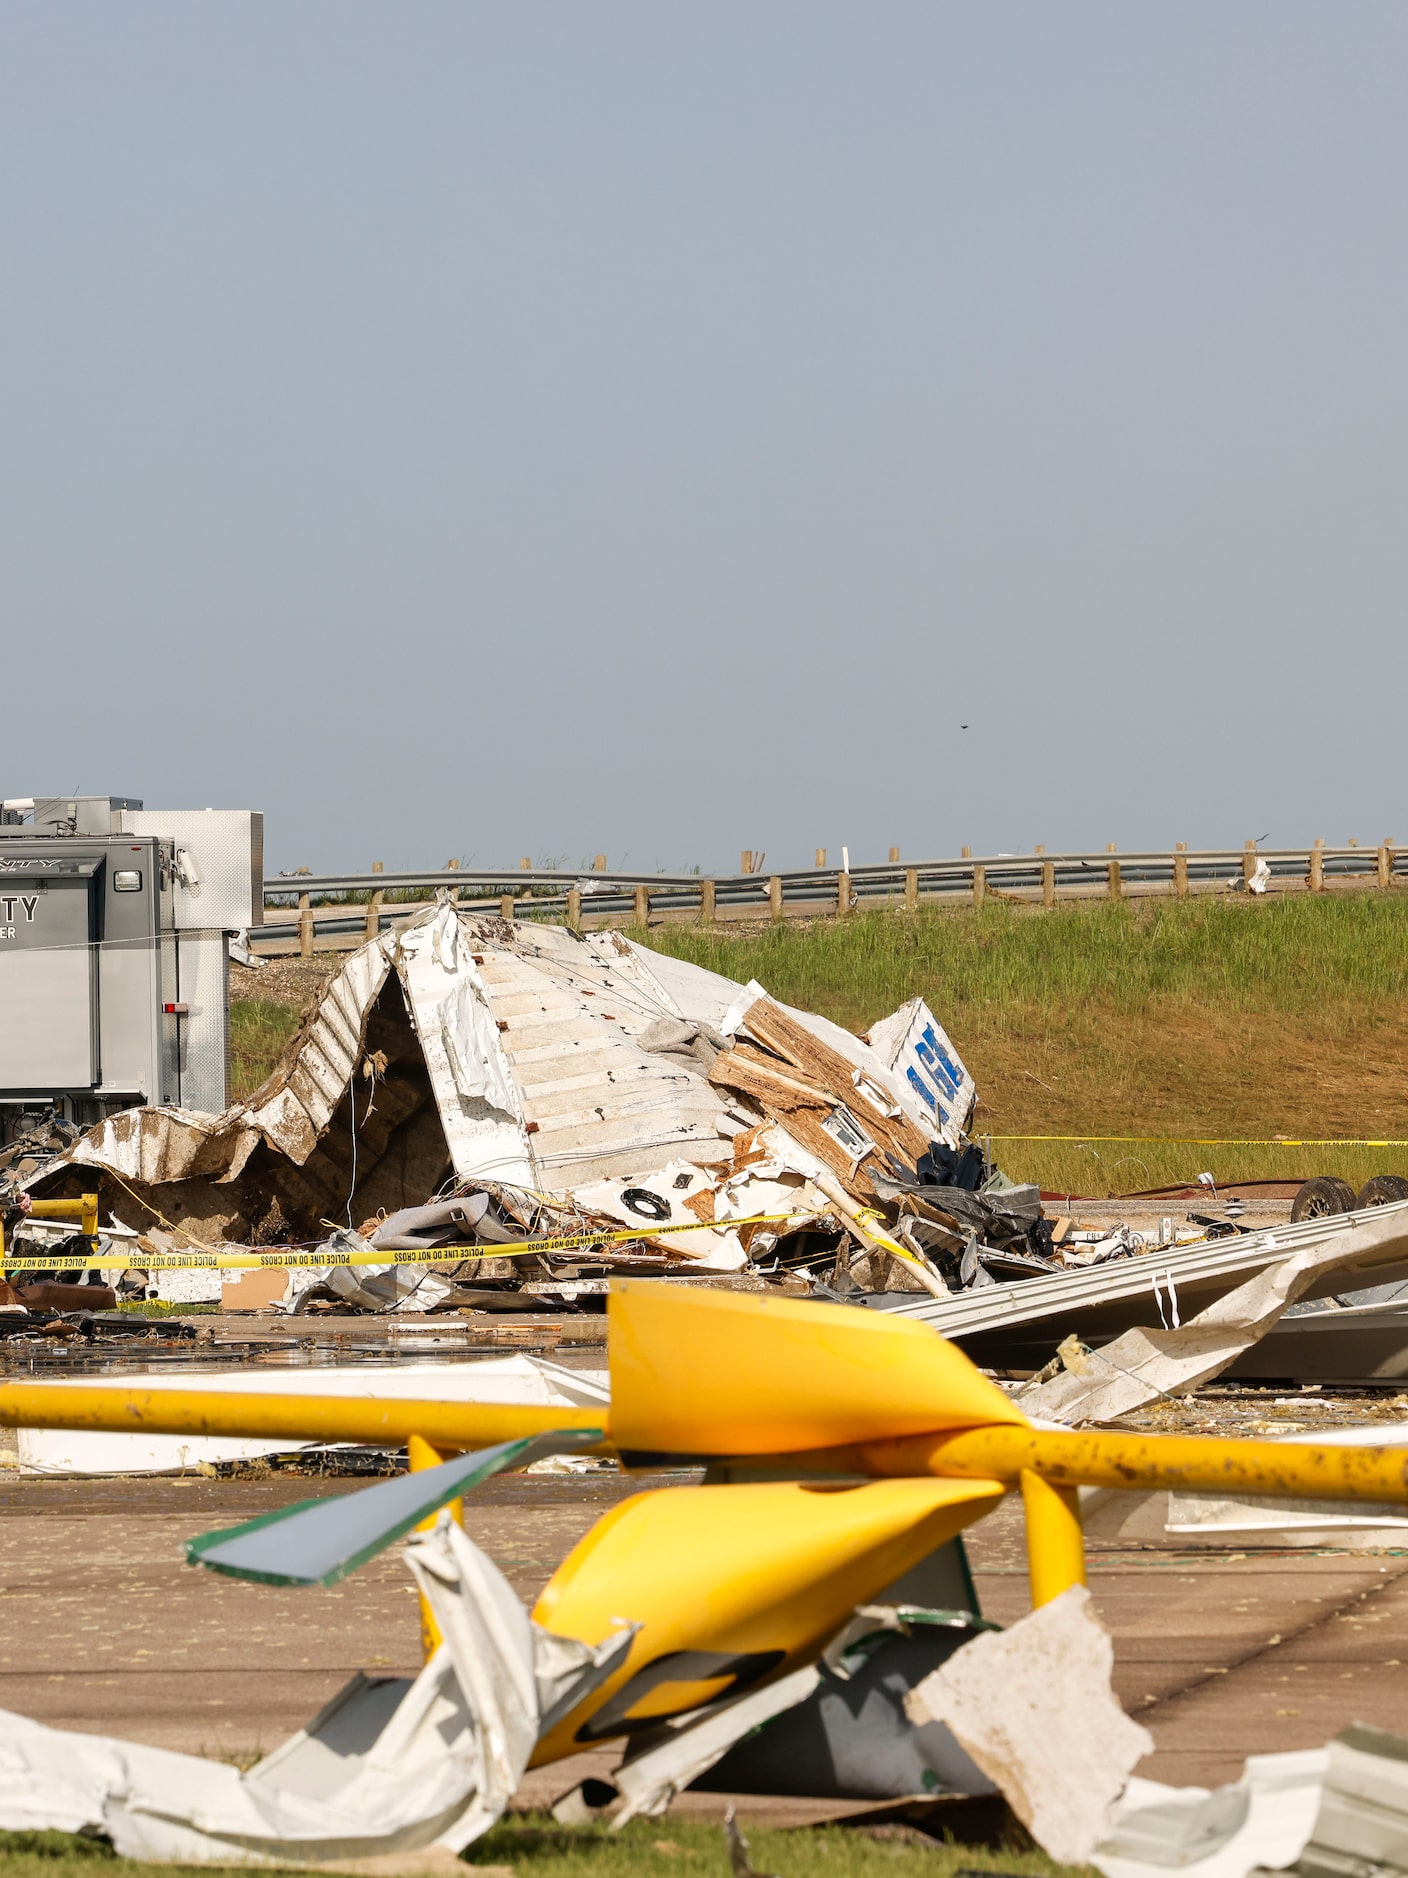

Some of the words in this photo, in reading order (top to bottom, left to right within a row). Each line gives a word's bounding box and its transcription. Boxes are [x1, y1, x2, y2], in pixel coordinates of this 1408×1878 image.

[565, 1239, 575, 1247] DO
[576, 1237, 591, 1246] LINE
[592, 1234, 616, 1244] POLICE
[527, 1242, 549, 1252] CROSS
[550, 1240, 564, 1249] NOT
[394, 1252, 416, 1262] CROSS
[418, 1251, 431, 1261] NOT
[433, 1250, 442, 1260] DO
[444, 1249, 459, 1259] LINE
[460, 1248, 484, 1258] POLICE
[0, 1259, 22, 1268] CROSS
[23, 1259, 36, 1268] NOT
[37, 1259, 47, 1268] DO
[47, 1258, 63, 1267] LINE
[63, 1258, 87, 1267] POLICE
[129, 1257, 151, 1267] CROSS
[152, 1257, 166, 1266] NOT
[166, 1257, 176, 1266] DO
[177, 1256, 192, 1266] LINE
[194, 1256, 217, 1266] POLICE
[260, 1255, 283, 1266] CROSS
[284, 1255, 297, 1265] NOT
[299, 1255, 309, 1265] DO
[310, 1255, 325, 1264] LINE
[326, 1254, 350, 1264] POLICE
